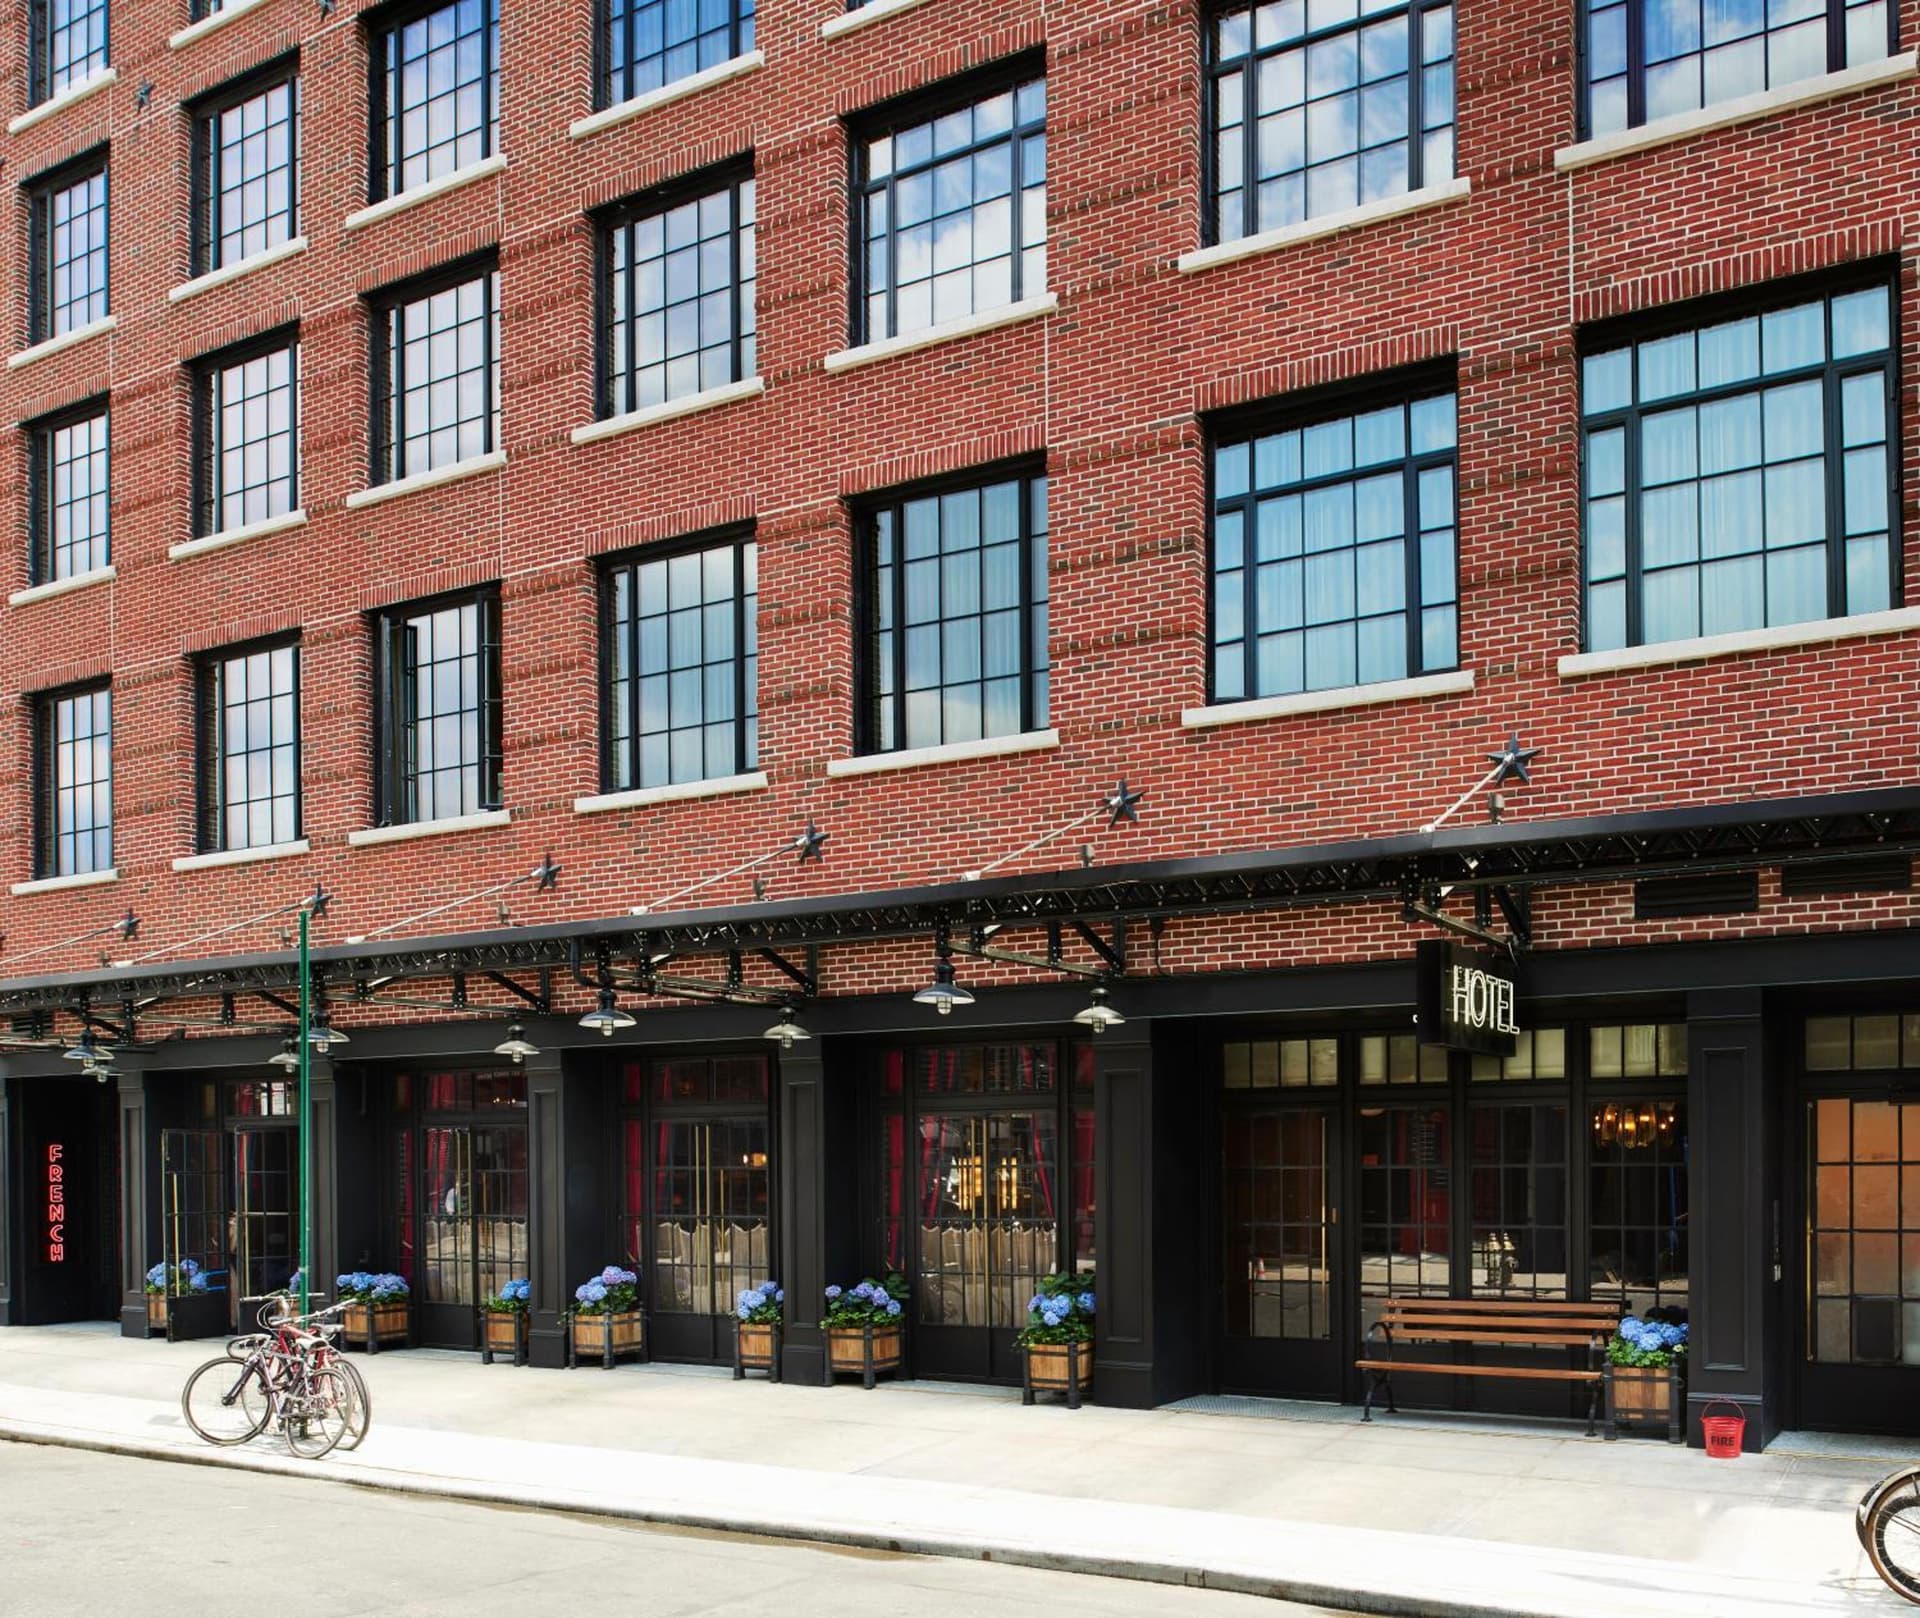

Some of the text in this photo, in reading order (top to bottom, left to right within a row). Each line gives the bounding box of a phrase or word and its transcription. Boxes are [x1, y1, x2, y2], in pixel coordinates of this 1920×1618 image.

[1453, 964, 1520, 1035] HOTEL
[48, 1144, 64, 1262] FRENCH
[1710, 1435, 1736, 1447] FIRE
